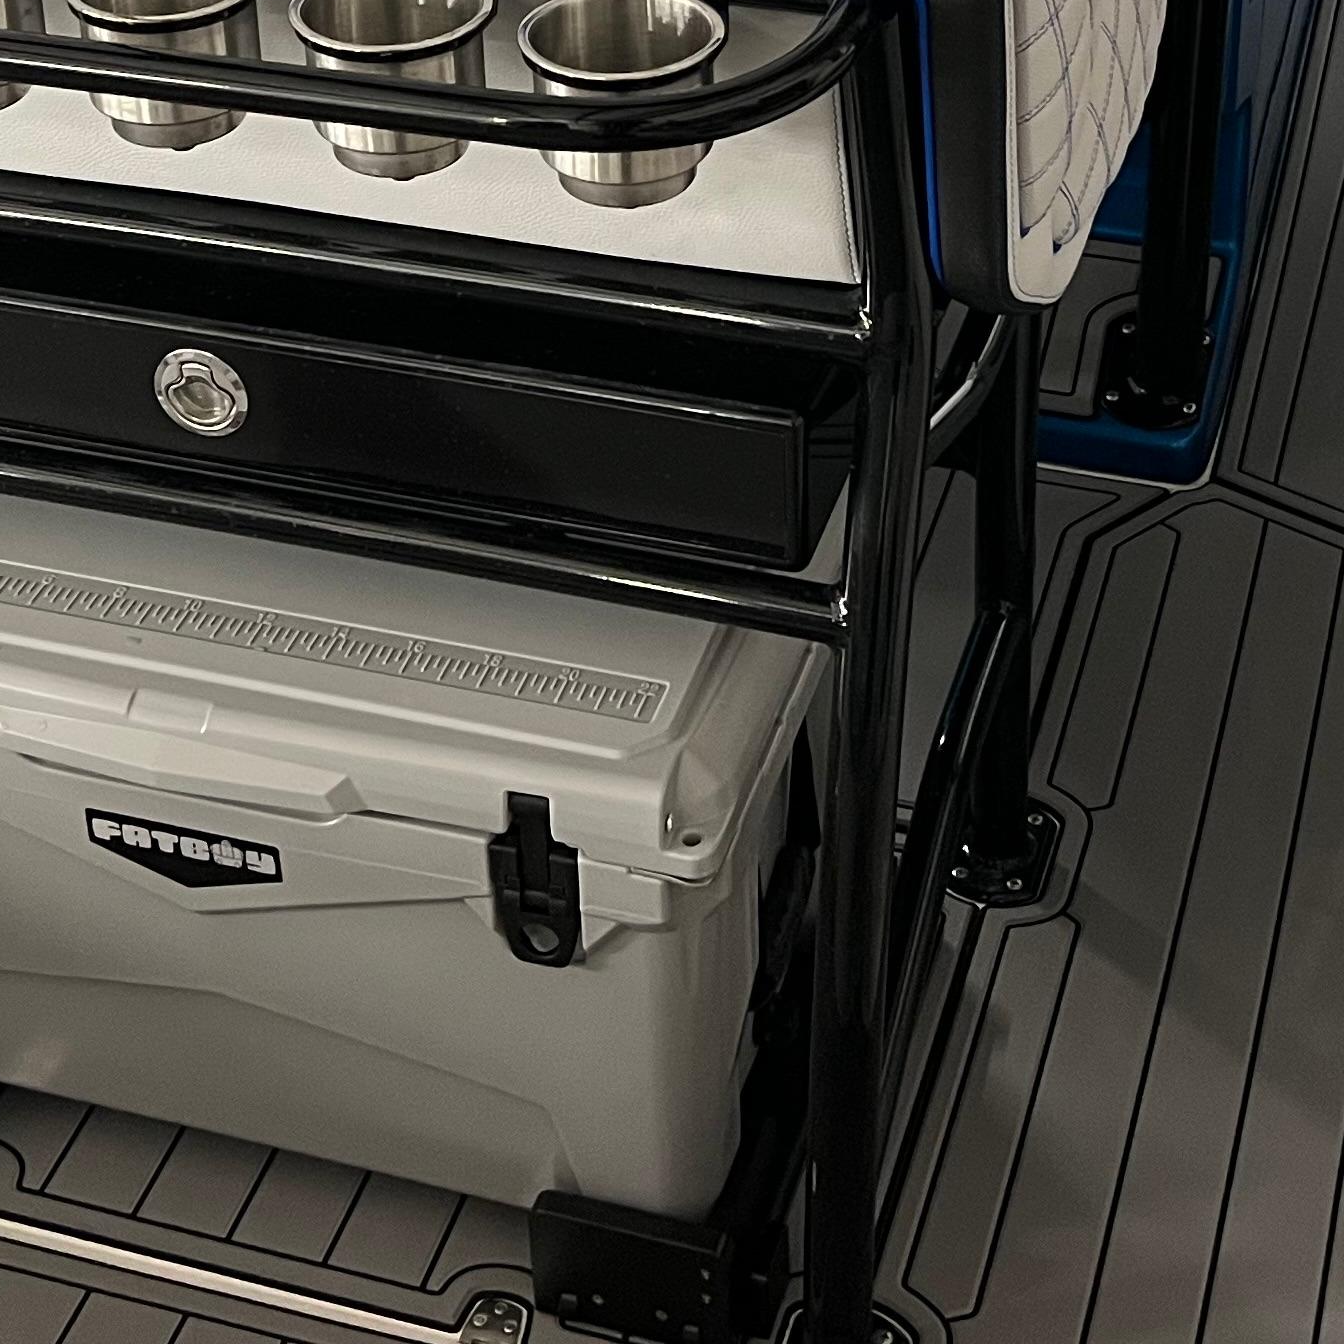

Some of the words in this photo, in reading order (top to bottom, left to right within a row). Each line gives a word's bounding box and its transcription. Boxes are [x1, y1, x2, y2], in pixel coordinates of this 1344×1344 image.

[113, 586, 129, 598] 8
[184, 599, 204, 612] 10
[256, 612, 277, 627] 12
[407, 640, 427, 653] 16
[483, 653, 504, 667] 18
[559, 667, 581, 681] 20
[637, 682, 660, 697] 22
[91, 817, 277, 876] FATBOY
